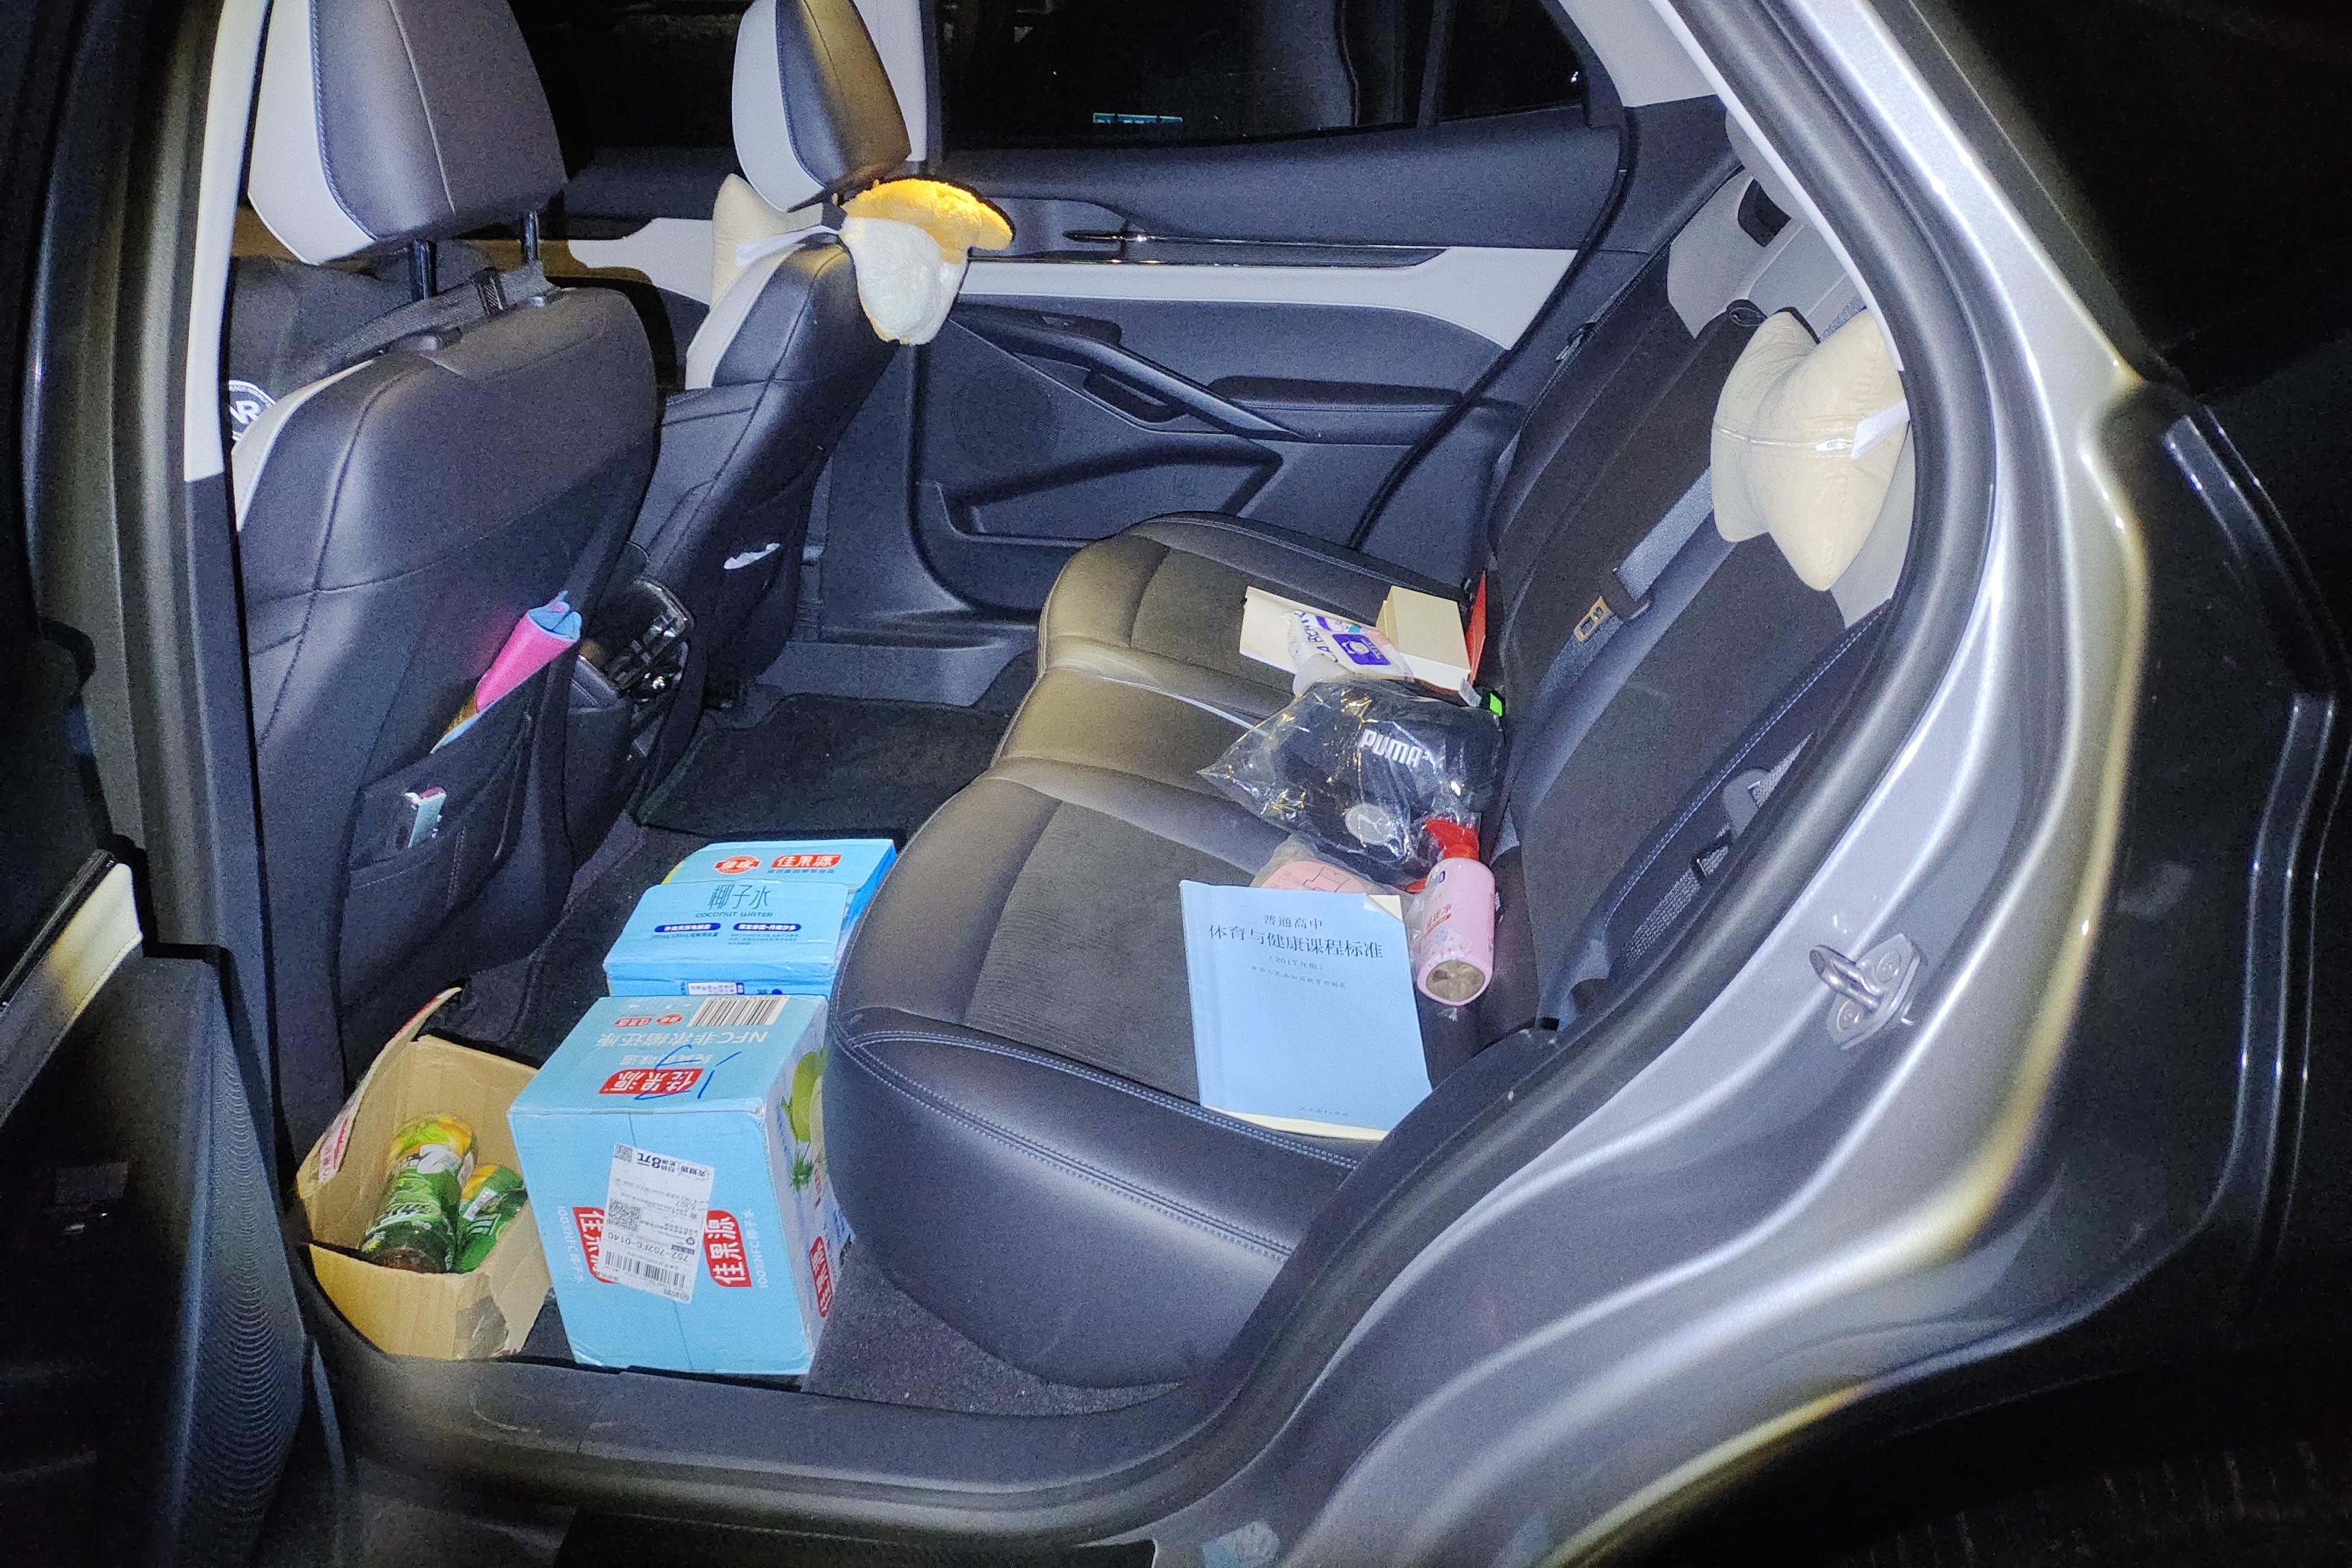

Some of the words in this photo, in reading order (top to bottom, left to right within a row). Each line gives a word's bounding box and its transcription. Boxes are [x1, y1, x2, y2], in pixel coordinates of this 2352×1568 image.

[1360, 729, 1425, 769] PUMA
[778, 855, 833, 867] 佳果源
[708, 884, 771, 909] 椰子水
[1264, 914, 1323, 930] 普通高中
[1208, 925, 1384, 958] 体育与健康课程标准
[610, 1071, 691, 1092] 佳果源
[705, 1217, 747, 1284] 佳果源
